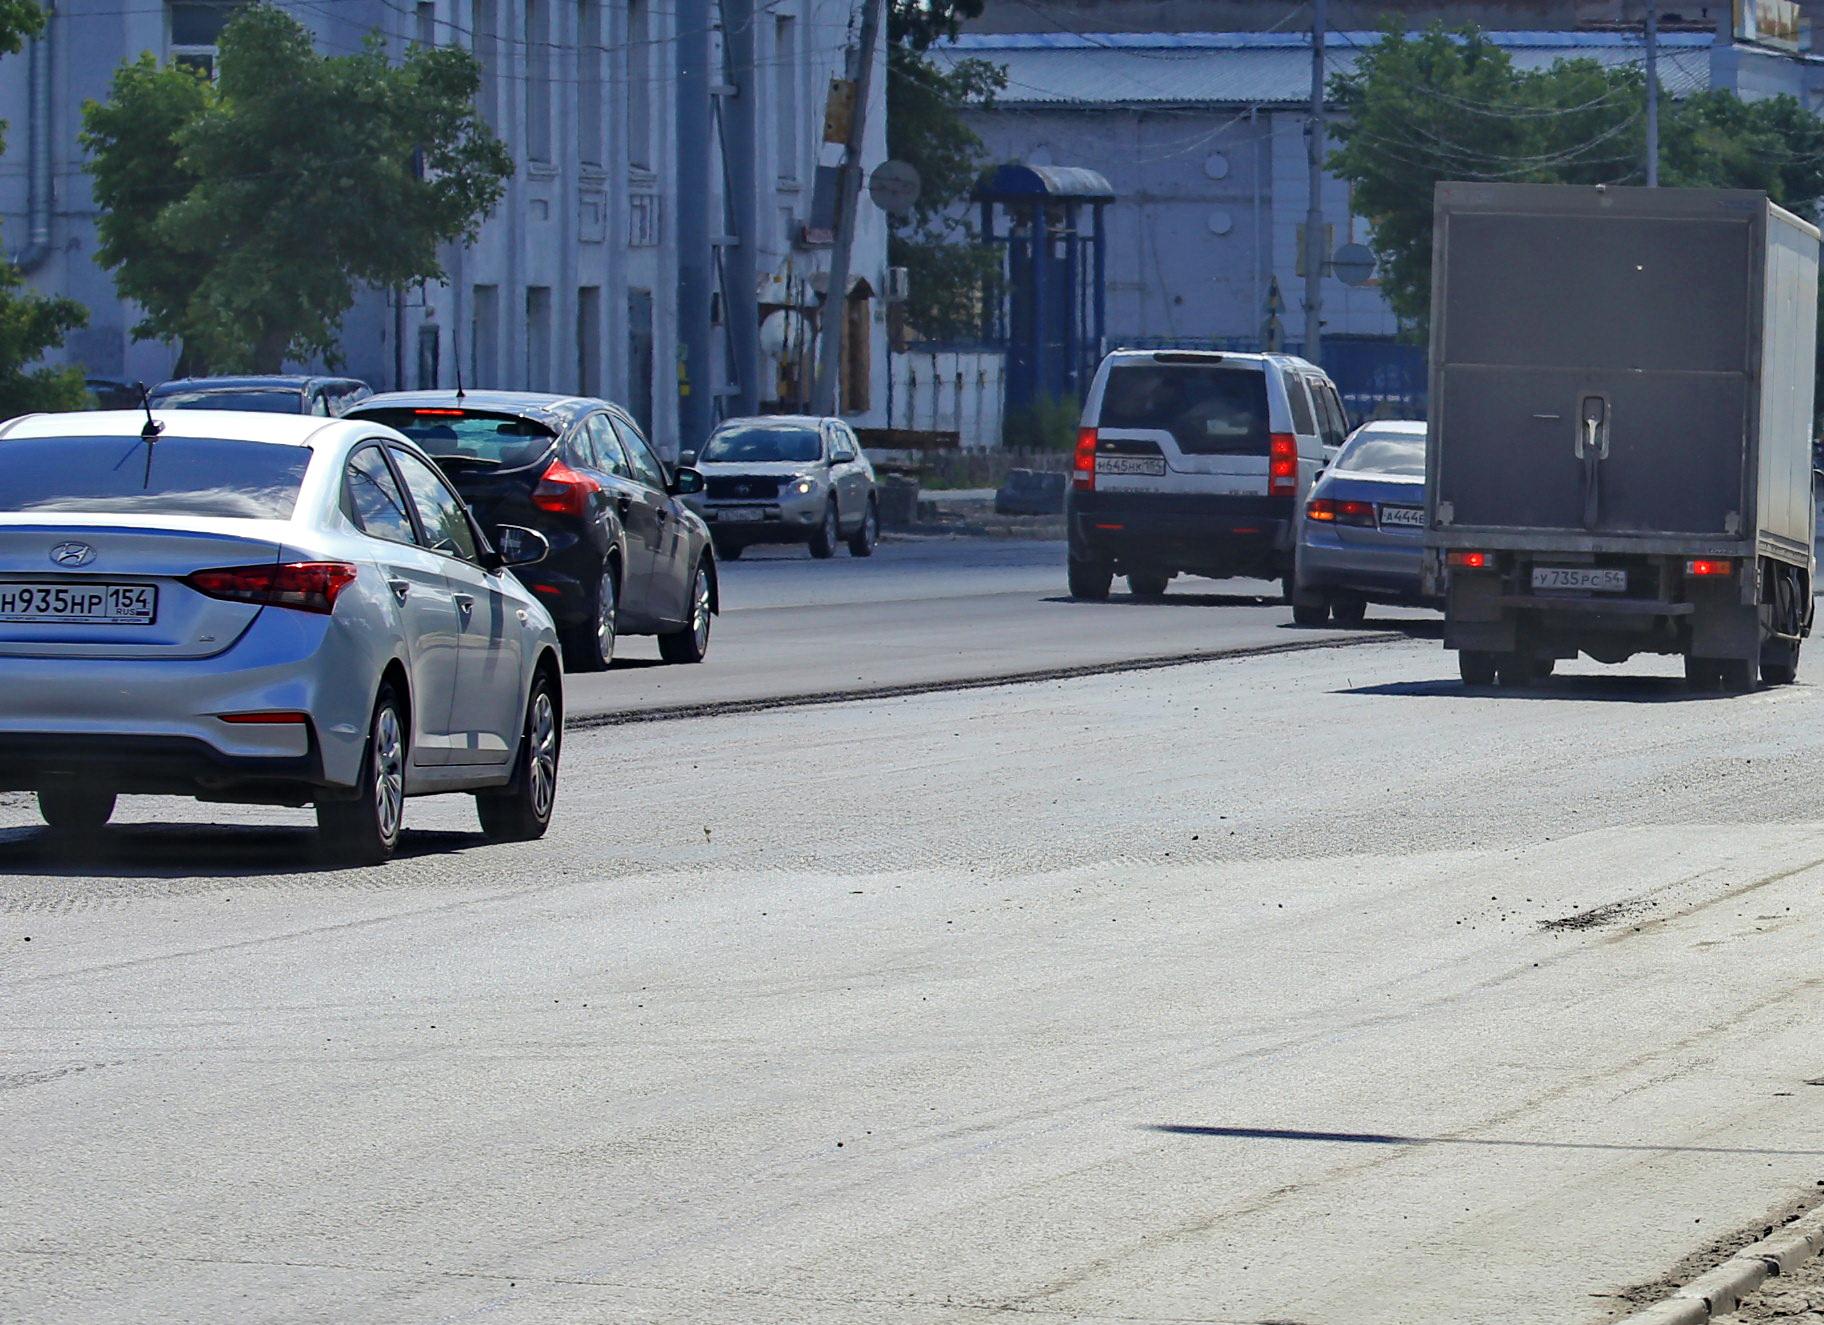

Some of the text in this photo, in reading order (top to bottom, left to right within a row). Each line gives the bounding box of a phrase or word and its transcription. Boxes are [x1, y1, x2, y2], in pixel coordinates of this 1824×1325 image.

[1386, 510, 1425, 524] А444Е
[1, 588, 148, 614] Н935НР 154
[116, 608, 136, 616] RUS
